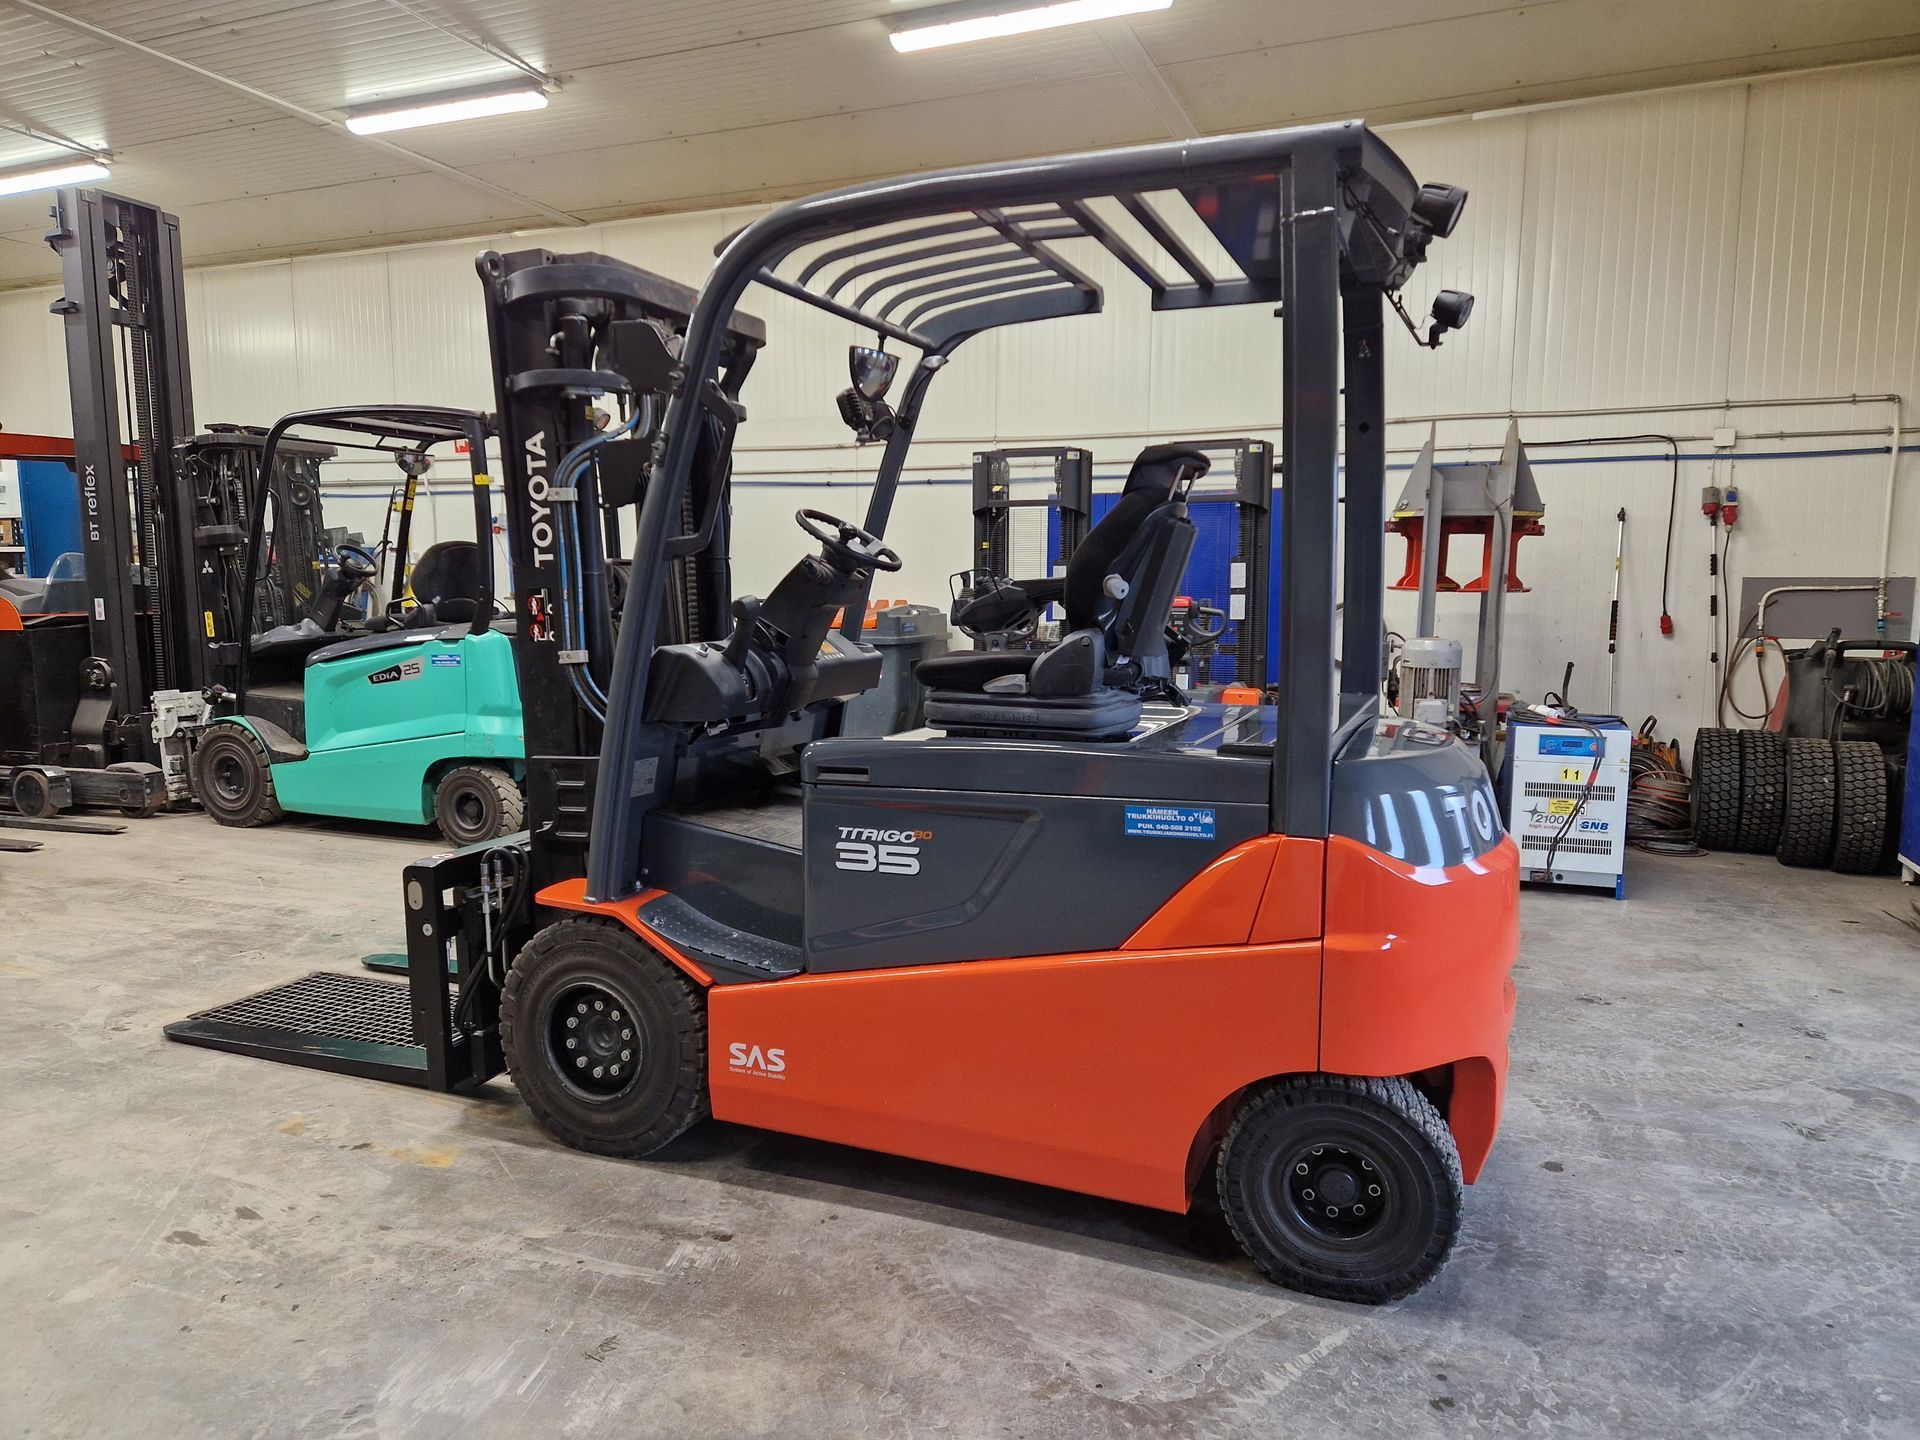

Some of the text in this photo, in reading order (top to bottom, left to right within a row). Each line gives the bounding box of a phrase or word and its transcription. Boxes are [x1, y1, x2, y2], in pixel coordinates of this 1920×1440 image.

[84, 464, 100, 541] BT reflex
[525, 430, 554, 568] TOYOTA
[403, 662, 420, 675] 25
[1126, 812, 1186, 822] TRUKKIHUOLTO
[1535, 813, 1565, 825] 2100
[1580, 821, 1609, 830] GNB
[836, 842, 920, 875] 35
[729, 1042, 786, 1072] SAS
